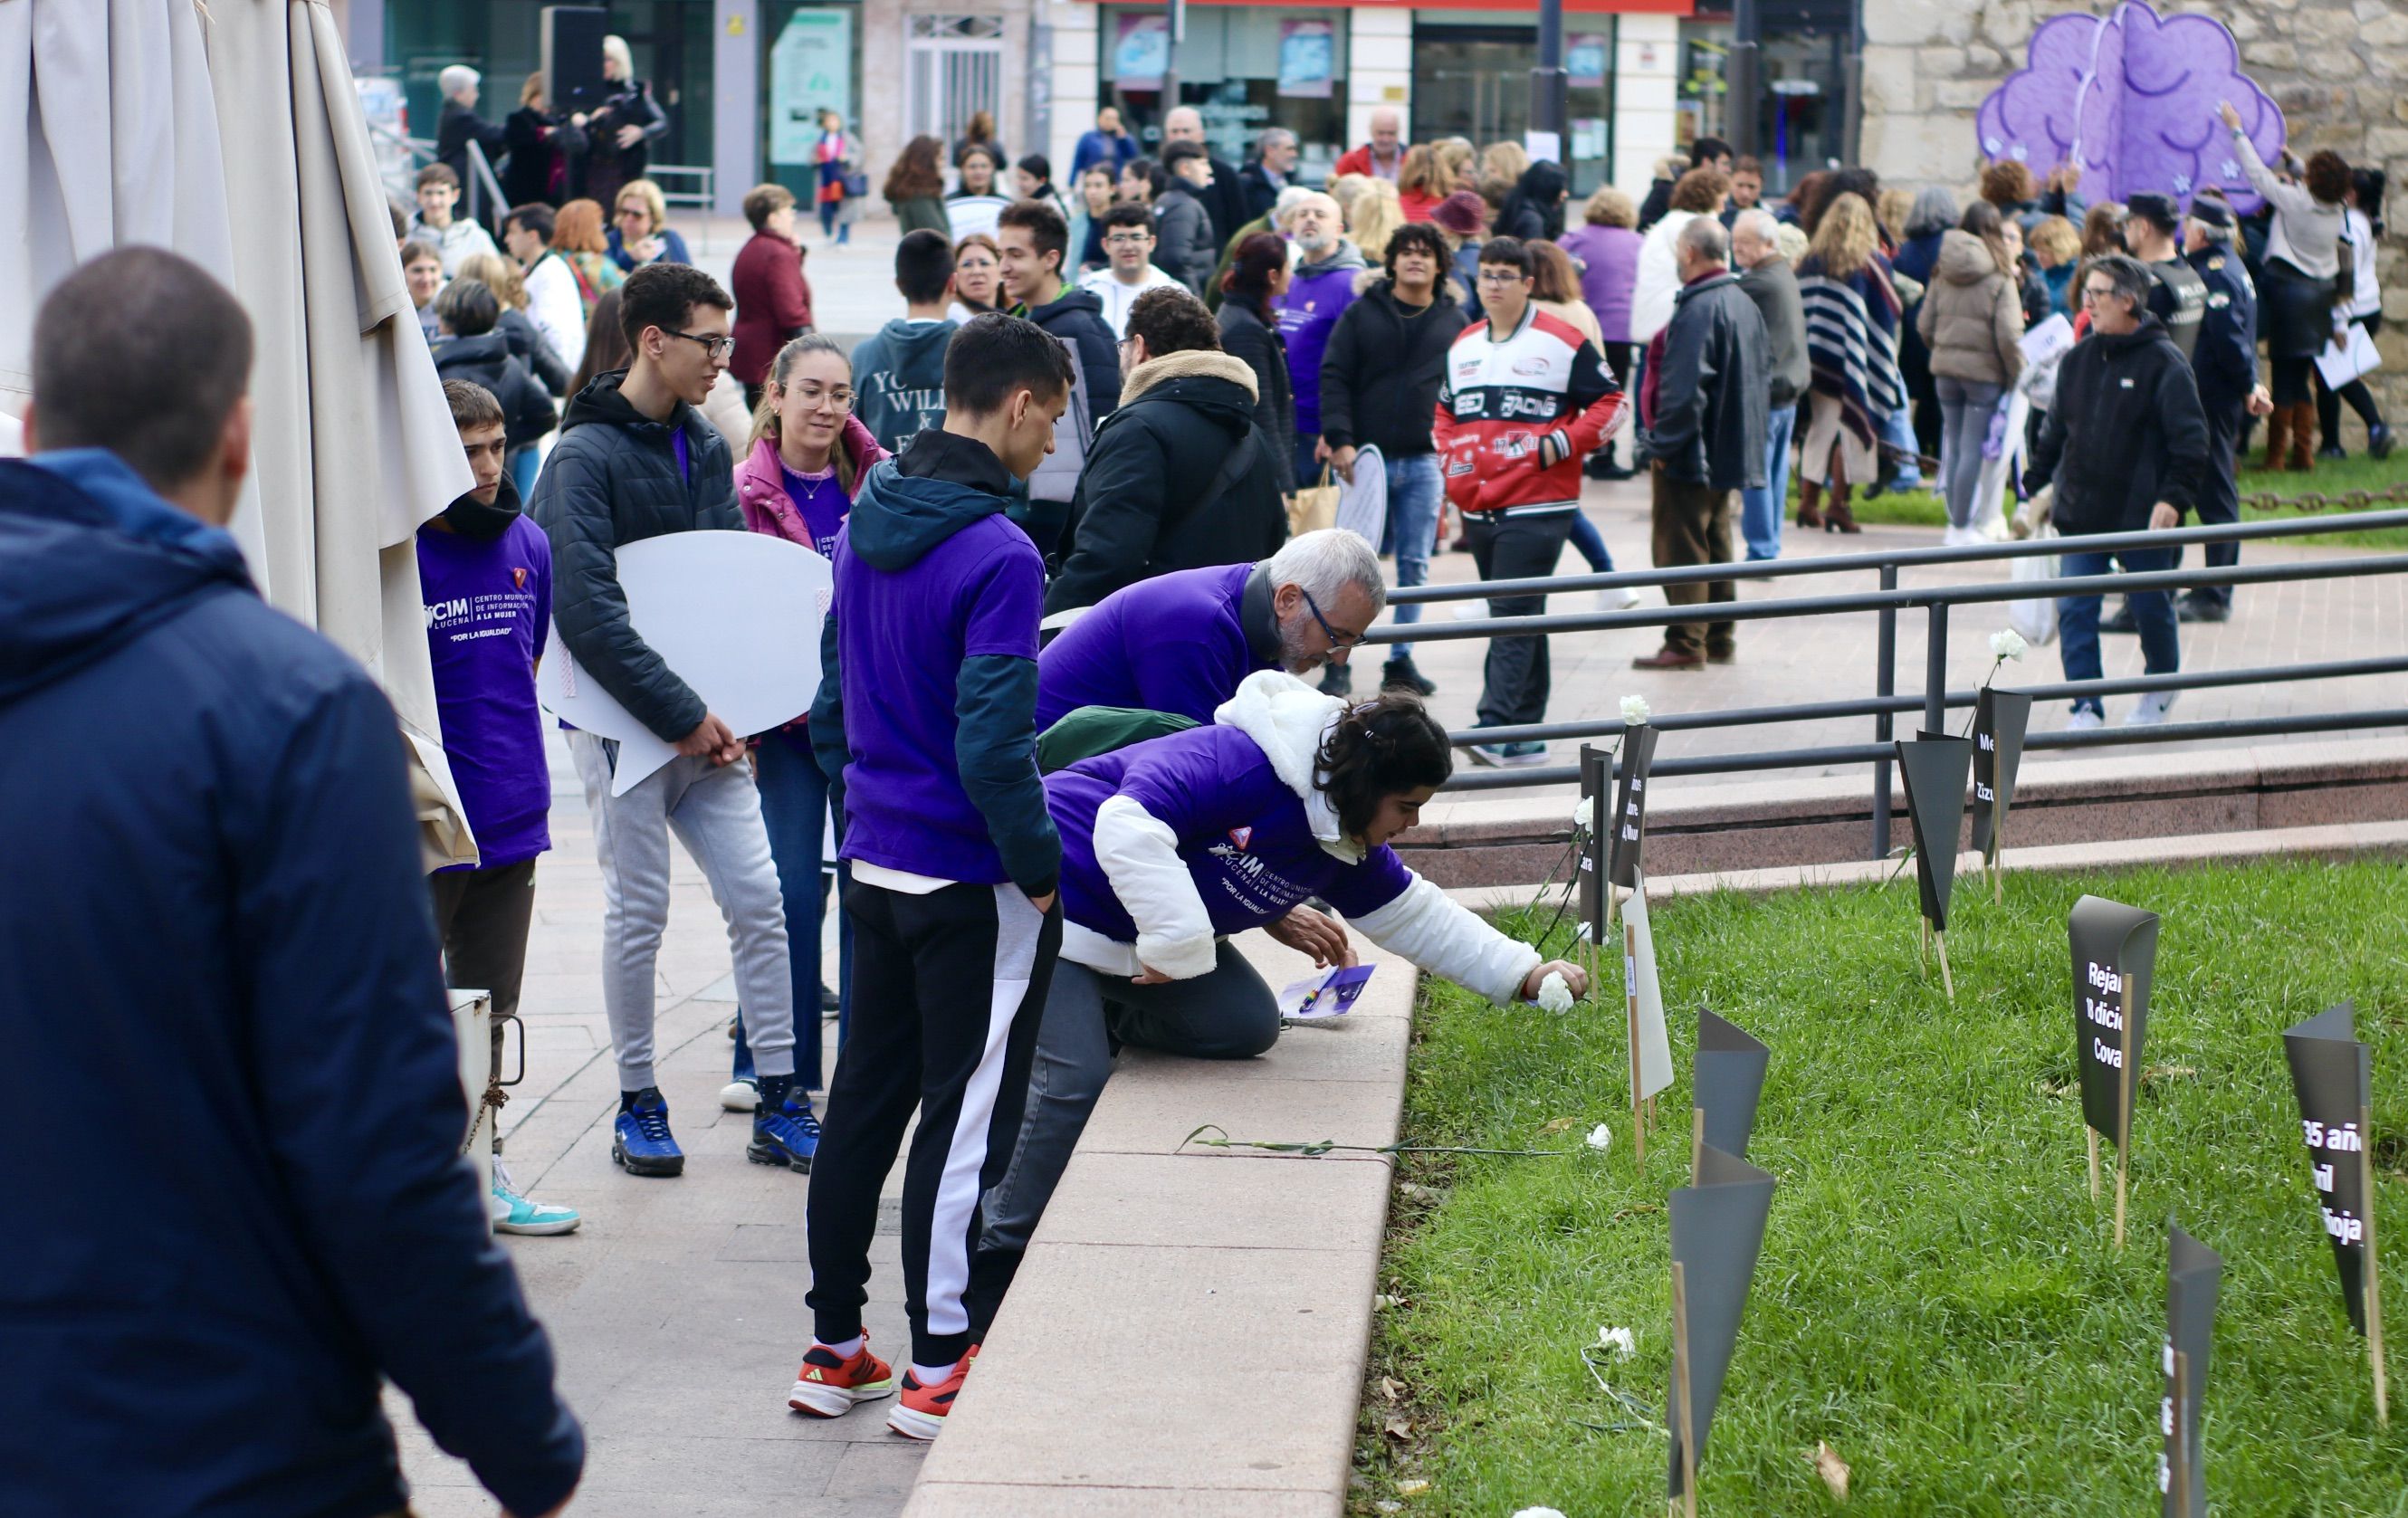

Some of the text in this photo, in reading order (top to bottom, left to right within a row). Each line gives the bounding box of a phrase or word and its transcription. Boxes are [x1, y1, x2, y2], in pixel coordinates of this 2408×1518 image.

[474, 594, 502, 604] CENTRO
[433, 597, 468, 621] CIM
[475, 604, 485, 613] DE
[483, 612, 492, 620] LA
[494, 610, 517, 619] MUJER
[435, 616, 470, 630] LUCENA
[469, 632, 479, 640] LA
[1259, 877, 1269, 886] DE
[1235, 892, 1245, 902] LA
[1259, 888, 1269, 898] LA
